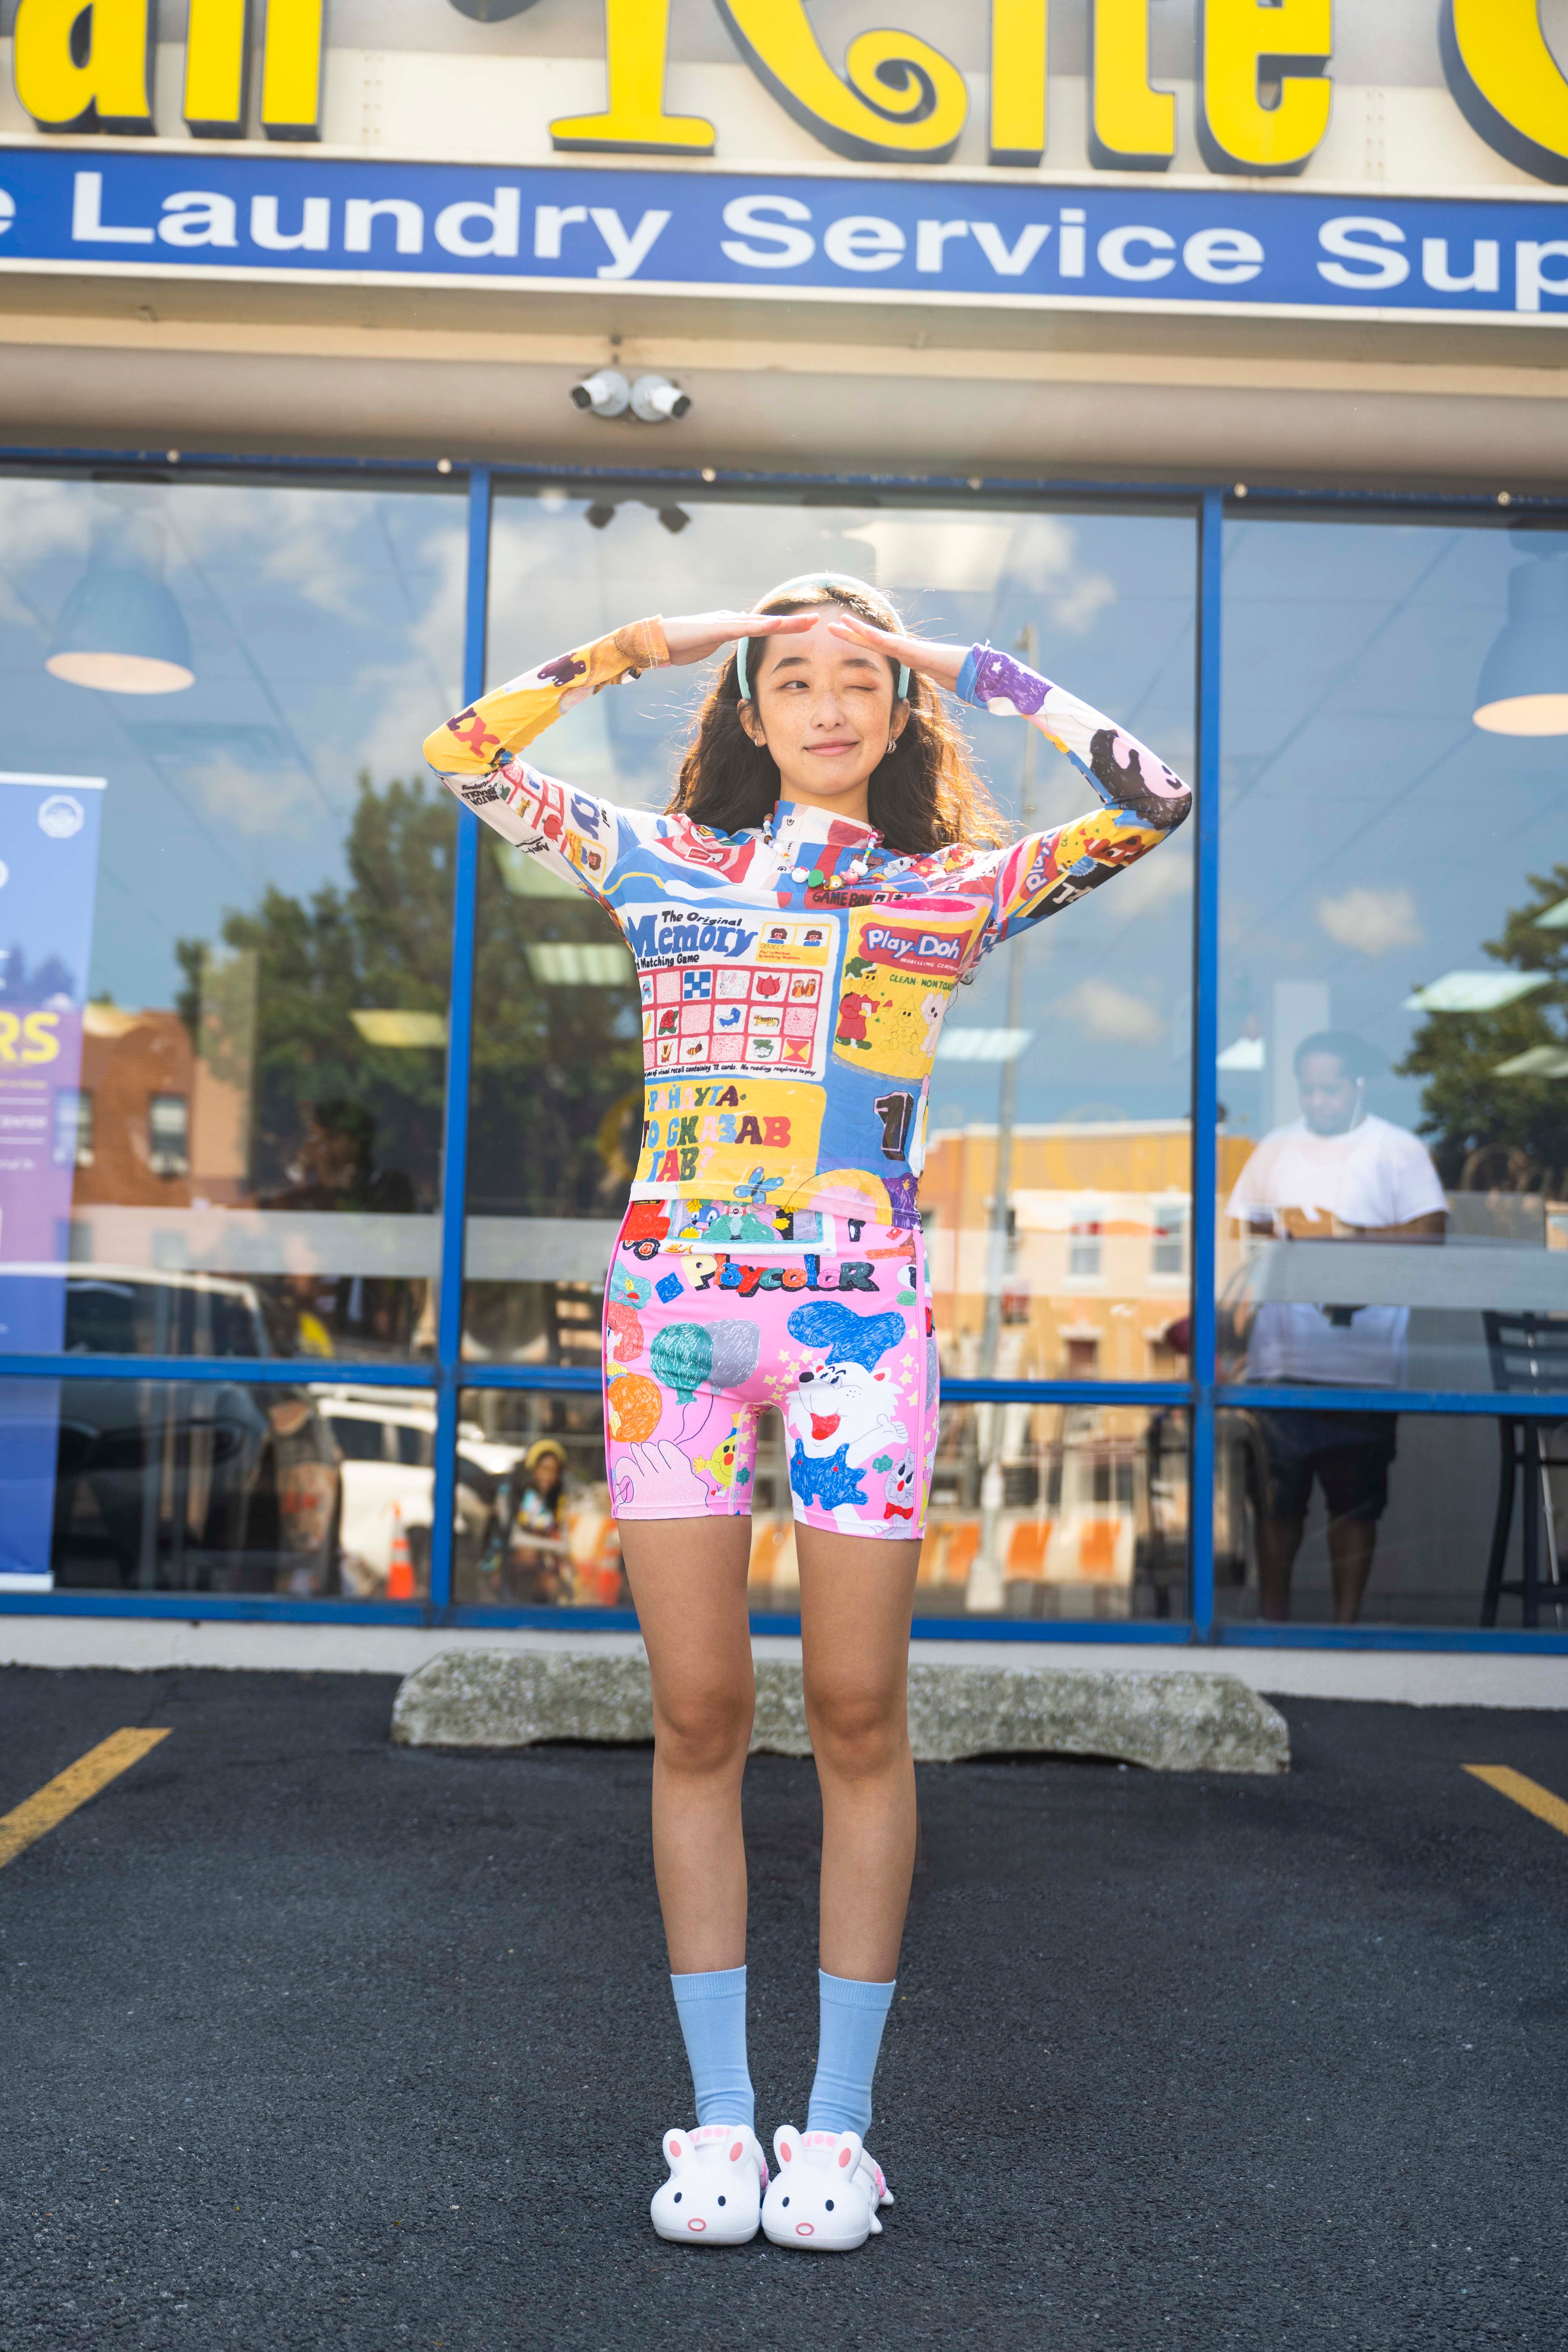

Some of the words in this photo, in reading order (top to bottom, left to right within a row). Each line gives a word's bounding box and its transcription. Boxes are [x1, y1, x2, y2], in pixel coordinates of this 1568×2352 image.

[71, 171, 673, 280] Laundry
[720, 194, 1265, 286] Service
[813, 892, 849, 906] GAME
[849, 892, 873, 907] BOY
[662, 910, 684, 923] The
[687, 912, 742, 926] Original
[627, 914, 758, 958] Memory
[866, 928, 962, 961] Play-Doh
[641, 956, 674, 969] Matching
[677, 954, 699, 964] Game
[889, 974, 916, 985] CLEAN
[686, 1064, 711, 1073] containing
[873, 1089, 914, 1162] 1
